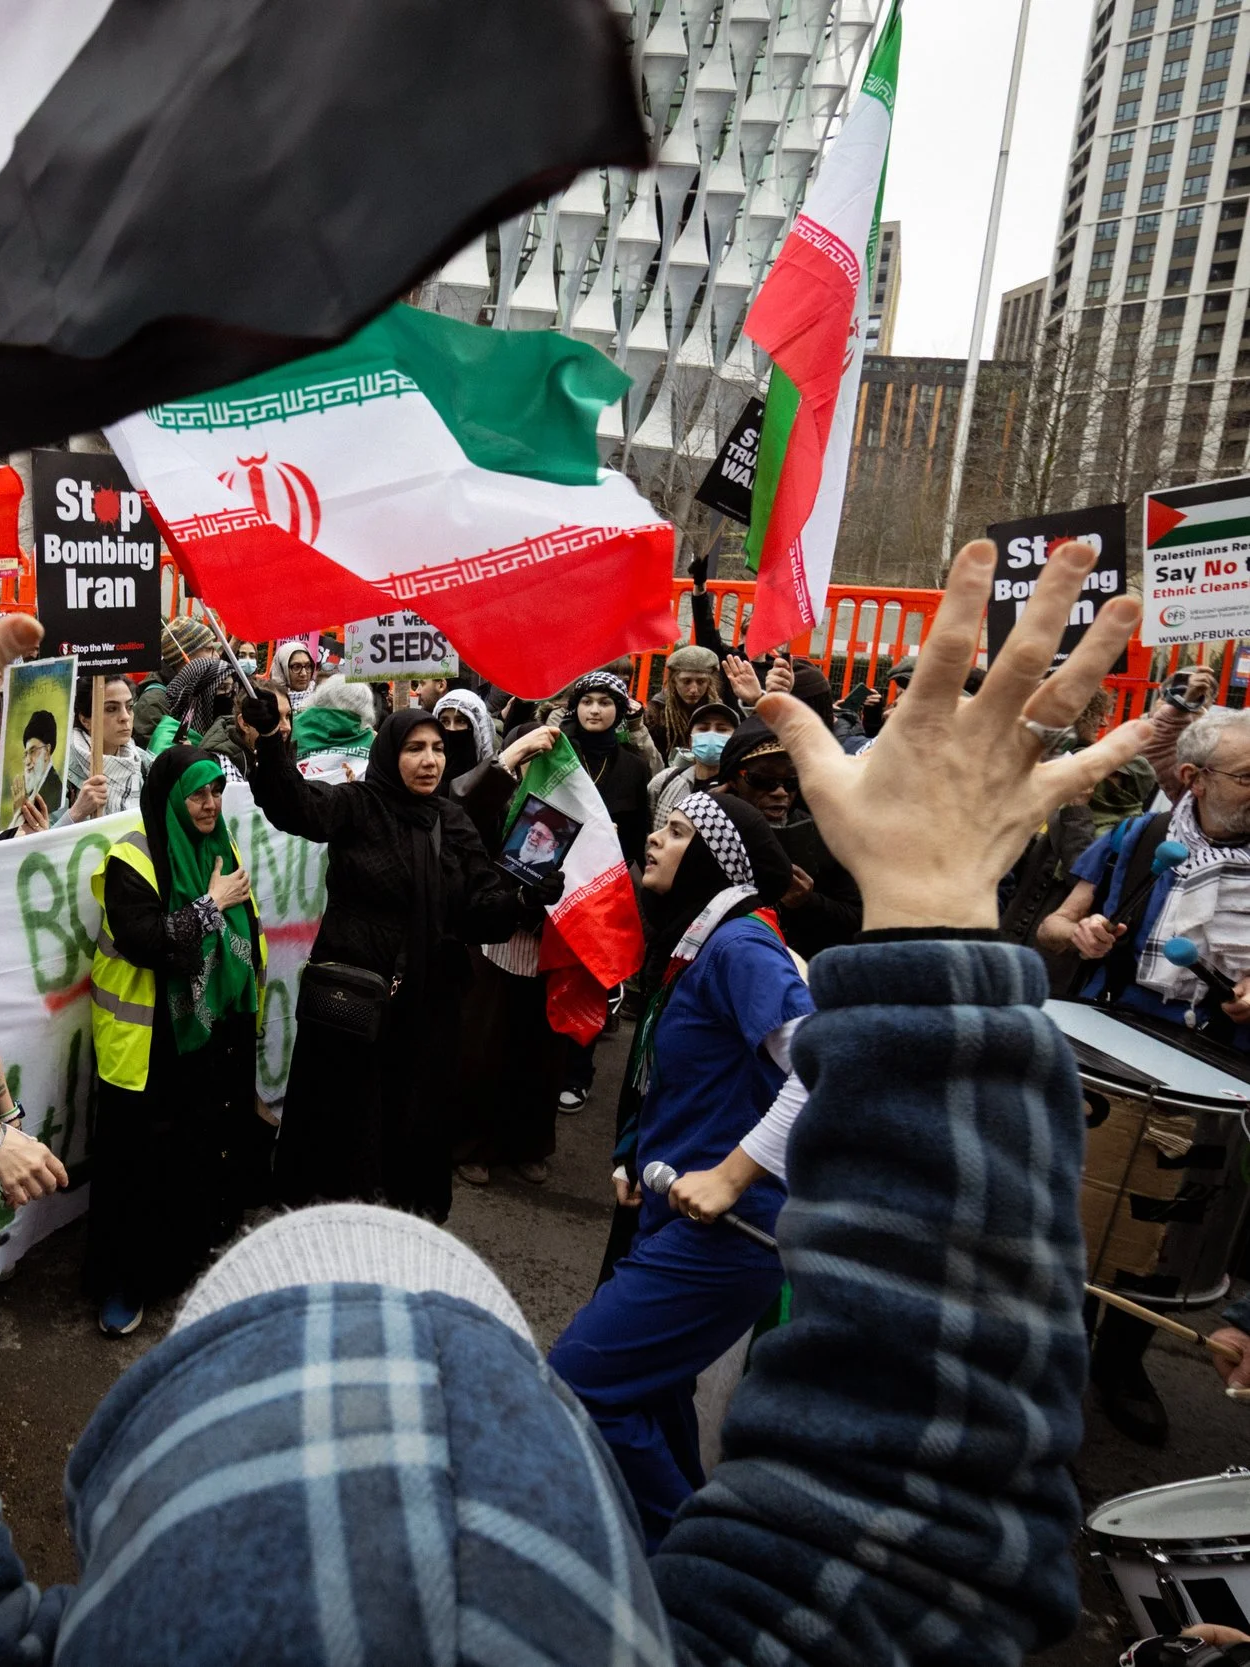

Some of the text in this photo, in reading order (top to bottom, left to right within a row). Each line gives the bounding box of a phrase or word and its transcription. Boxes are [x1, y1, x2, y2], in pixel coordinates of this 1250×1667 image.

[44, 533, 155, 571] Bombing
[1153, 545, 1228, 562] Palestinians
[1155, 567, 1197, 584] Say
[1205, 559, 1238, 577] No
[65, 567, 136, 609] Iran
[1153, 580, 1250, 599] Ethnic Cleans
[376, 615, 395, 627] WE
[71, 641, 145, 655] Stop the War coalition
